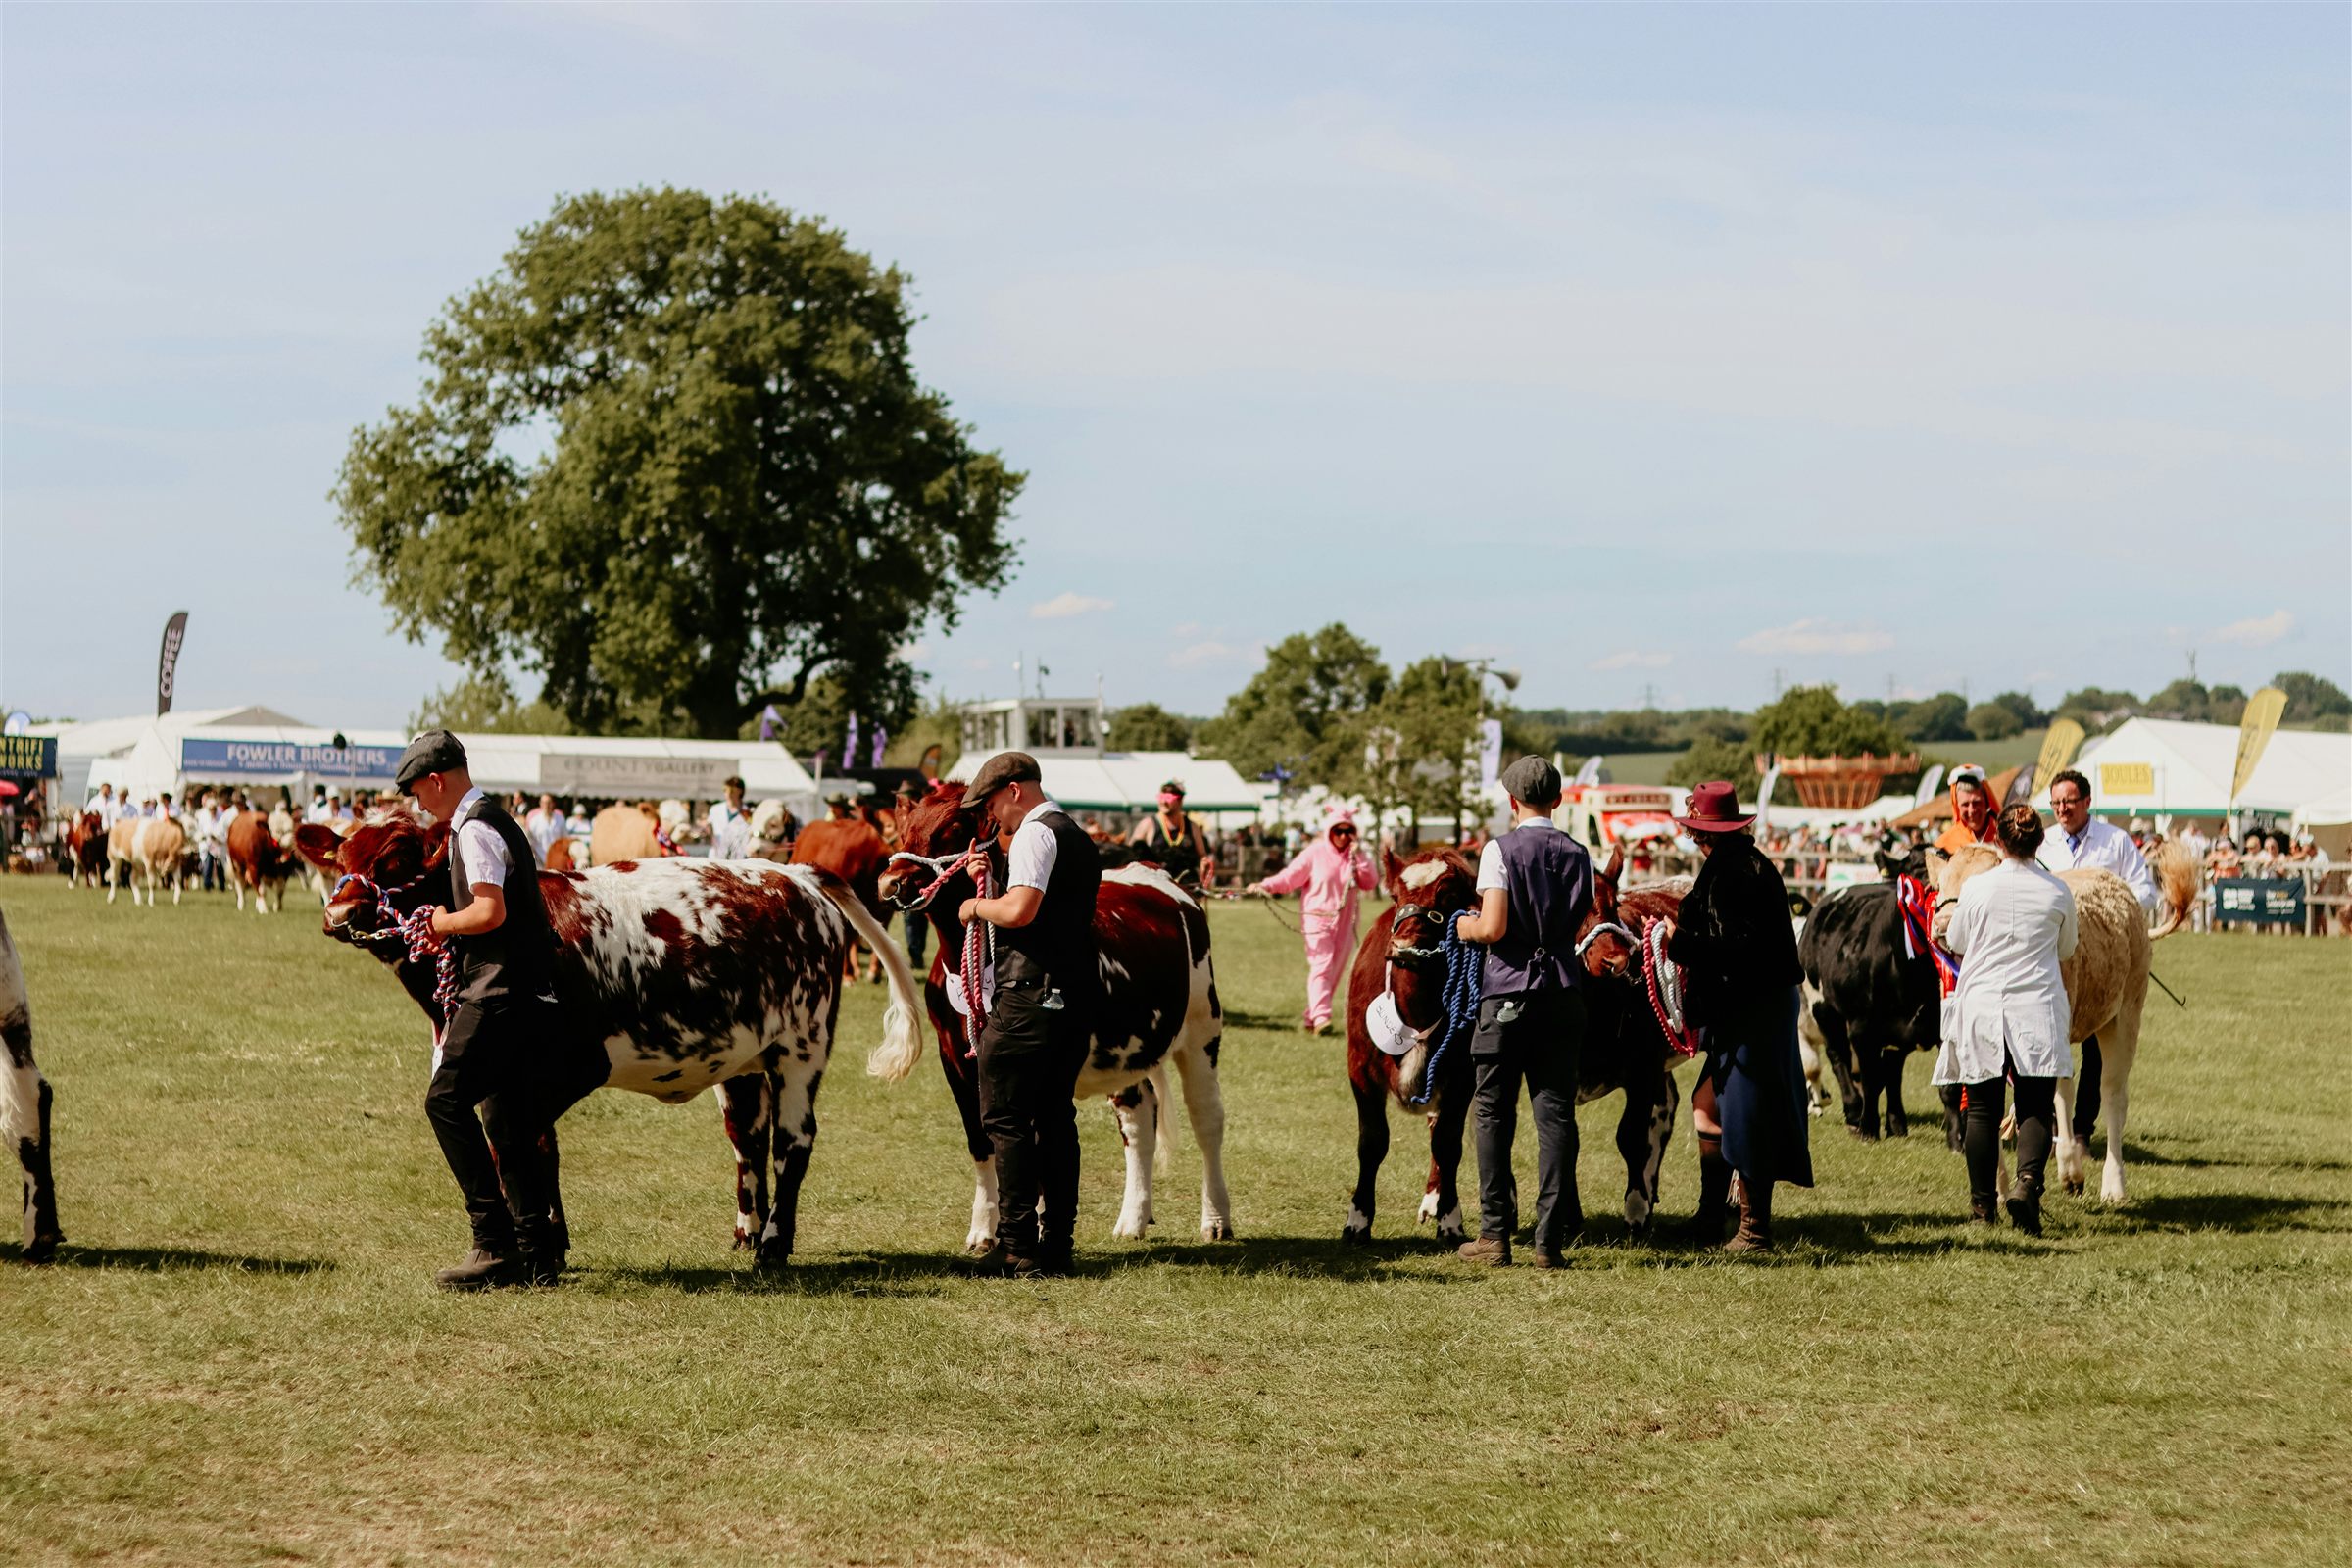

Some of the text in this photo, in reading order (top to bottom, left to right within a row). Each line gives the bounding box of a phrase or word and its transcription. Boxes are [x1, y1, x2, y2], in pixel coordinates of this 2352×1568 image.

[160, 627, 184, 698] COFFEE
[227, 743, 387, 765] FOWLER BROTHERS
